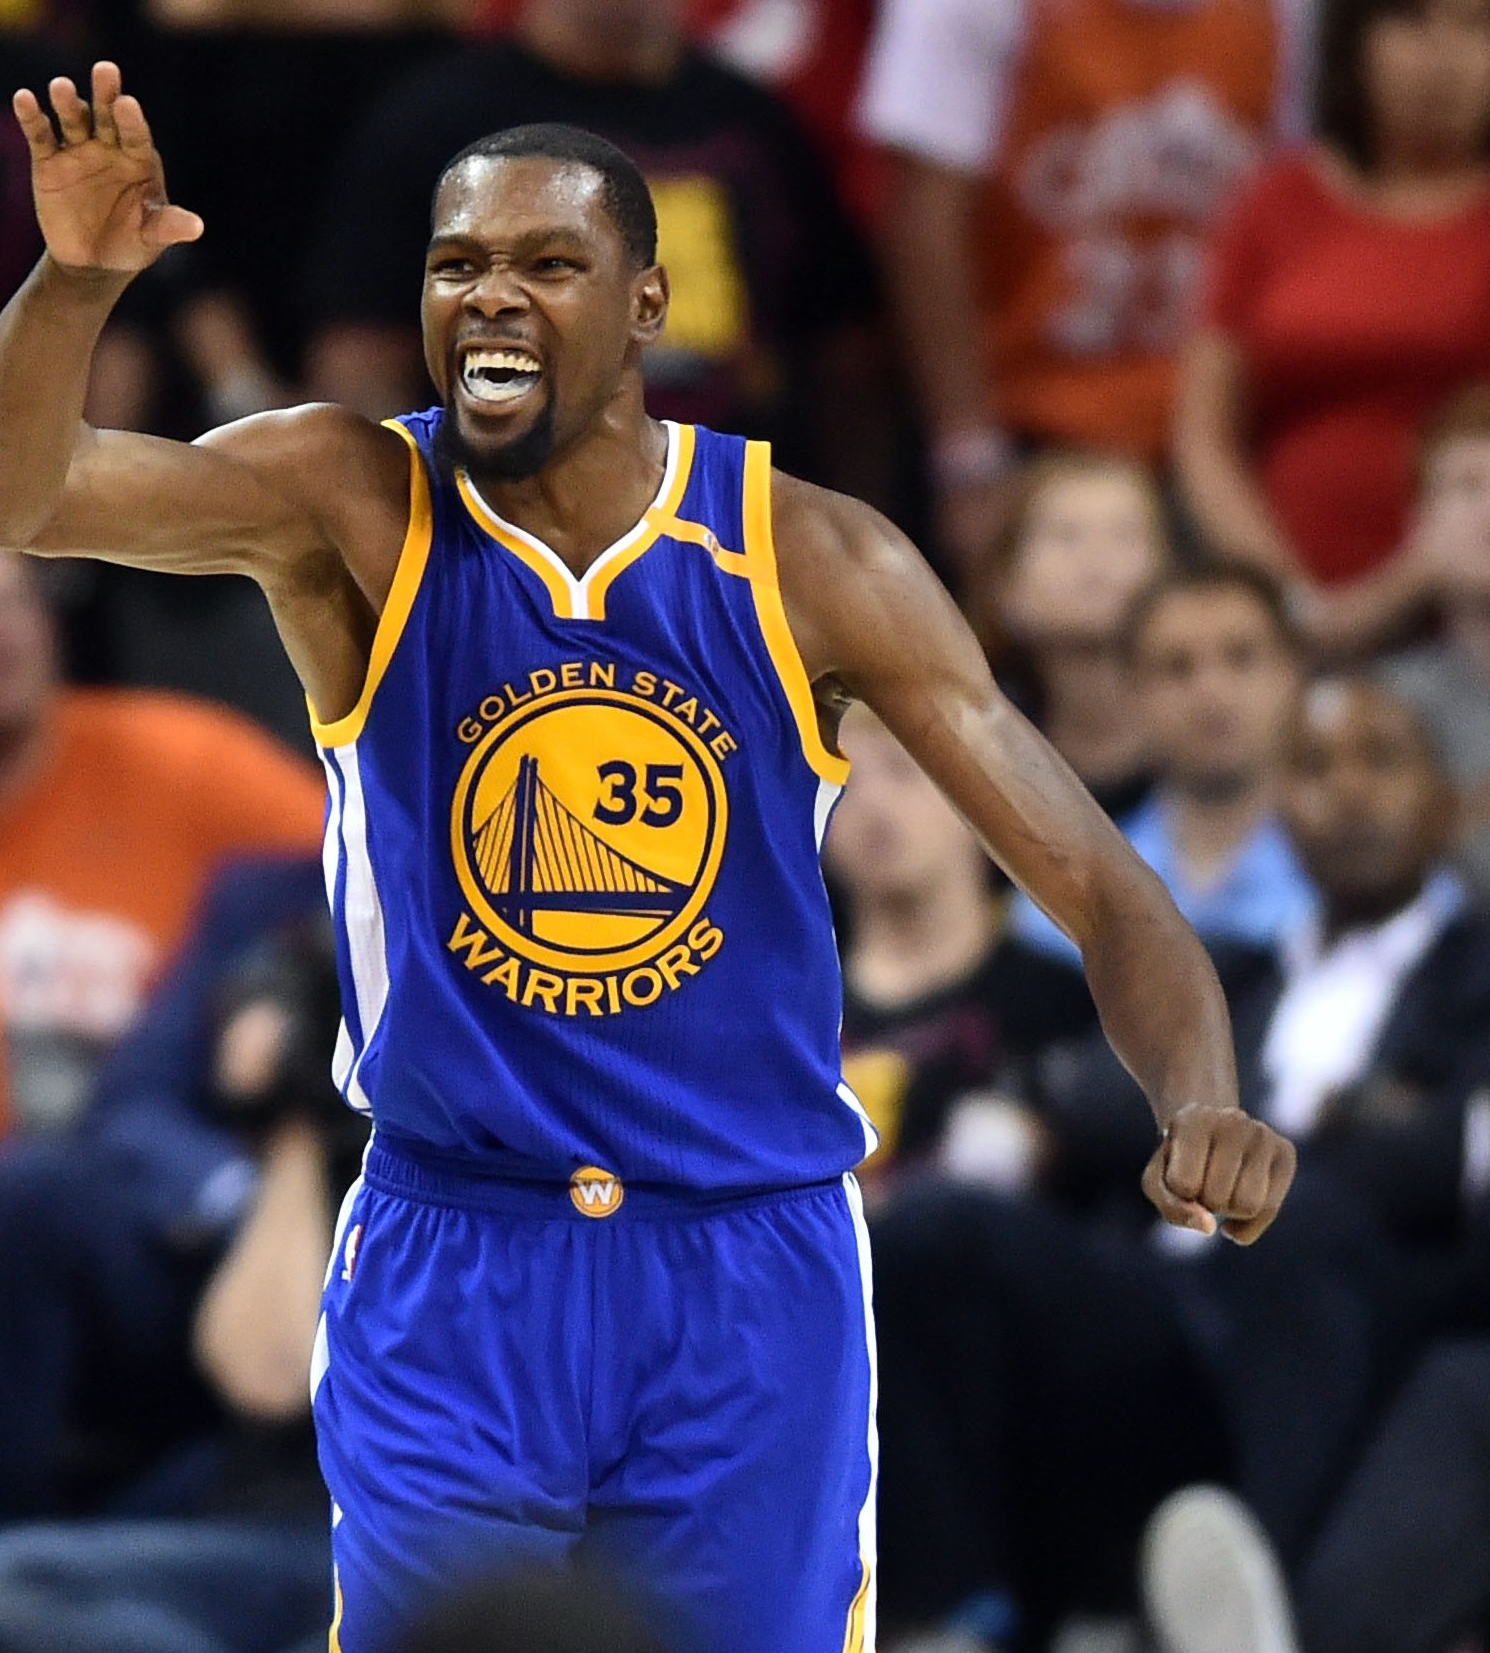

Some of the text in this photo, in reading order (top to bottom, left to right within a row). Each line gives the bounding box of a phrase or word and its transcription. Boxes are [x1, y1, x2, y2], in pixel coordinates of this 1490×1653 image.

[458, 662, 737, 761] GOLDEN STATE
[594, 760, 684, 828] 35
[447, 911, 724, 1017] WARRIORS
[577, 1180, 614, 1205] W
